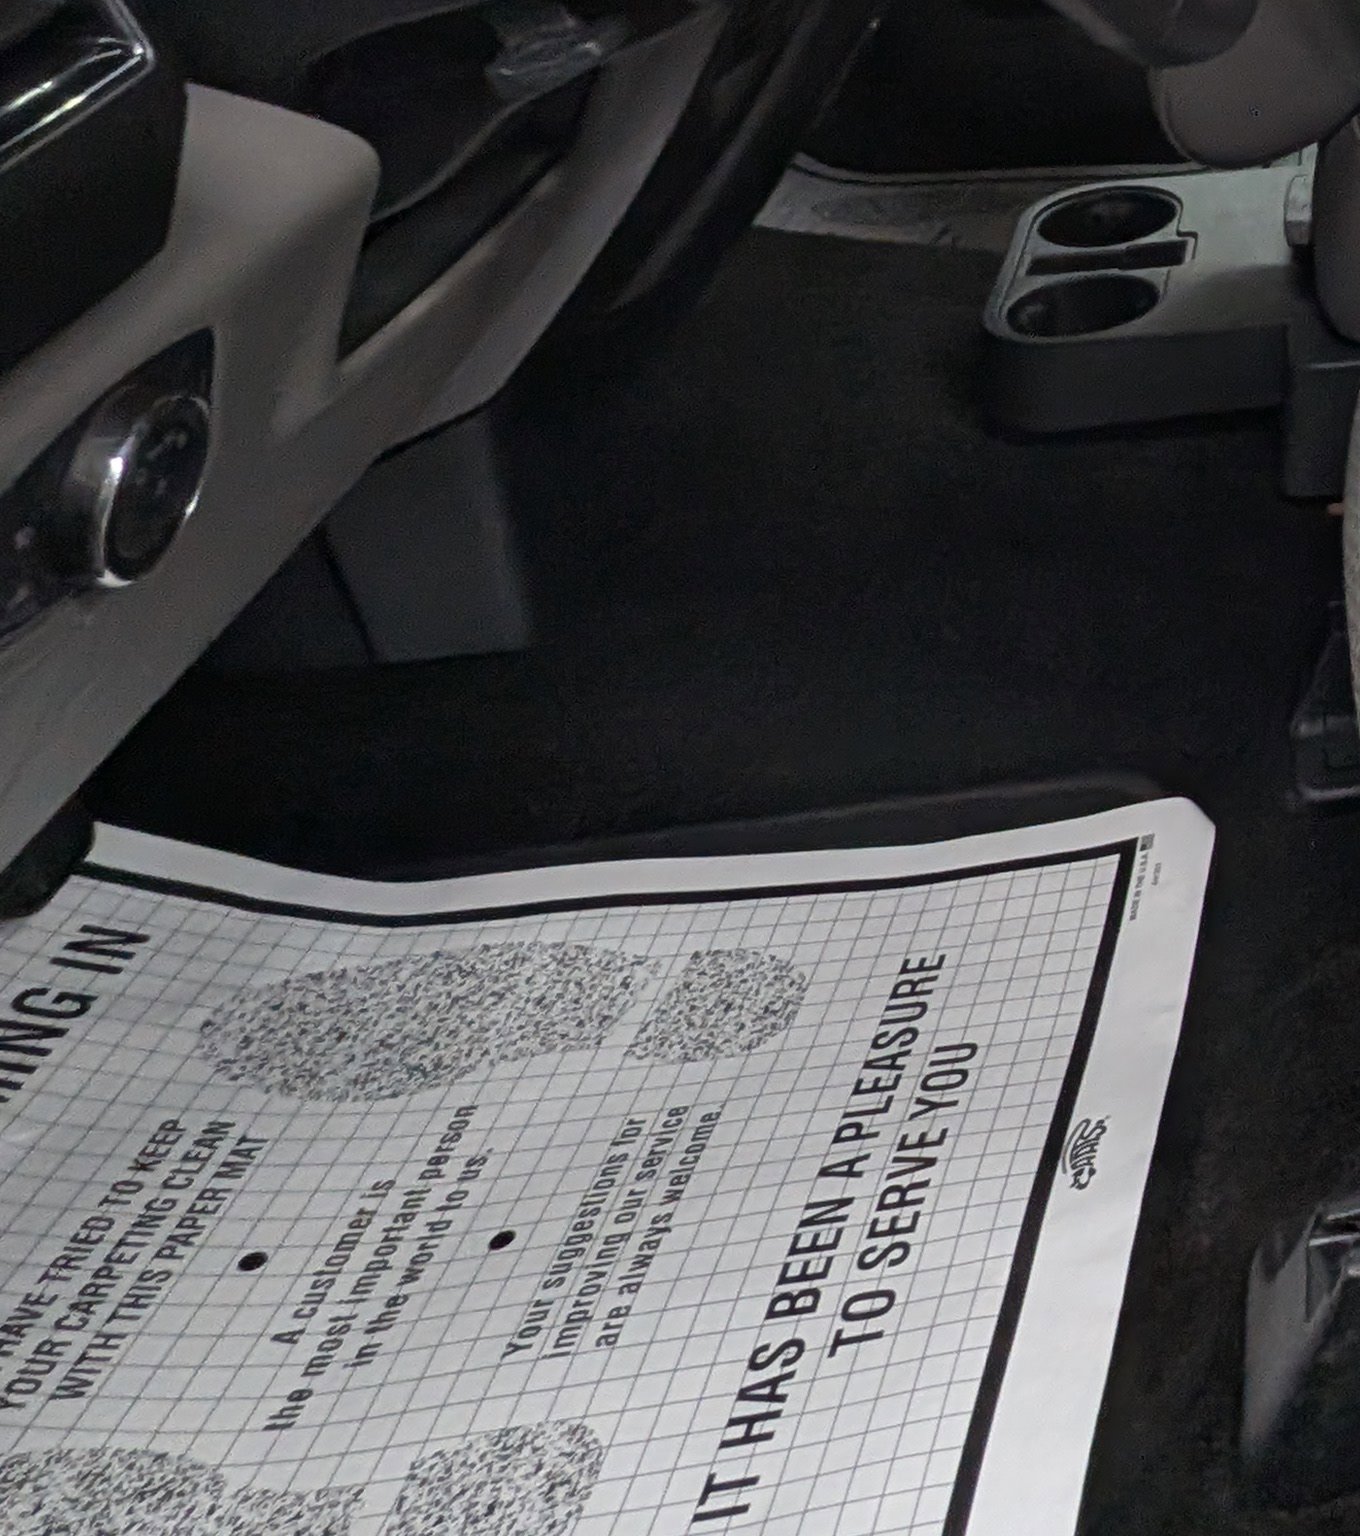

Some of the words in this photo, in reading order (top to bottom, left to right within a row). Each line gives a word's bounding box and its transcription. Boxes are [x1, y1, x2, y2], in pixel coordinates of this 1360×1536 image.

[50, 924, 150, 975] IN
[832, 953, 947, 1146] PLEASURE
[909, 1042, 978, 1121] YOU
[38, 1216, 115, 1285] TRIED
[98, 1180, 144, 1208] TO
[127, 1118, 187, 1172] KEEP
[500, 1299, 554, 1360] Your
[543, 1152, 630, 1291] suggestions
[610, 1117, 647, 1148] for
[541, 1231, 632, 1359] improving
[614, 1189, 647, 1225] our
[636, 1105, 689, 1182] service
[595, 1304, 632, 1348] are
[618, 1212, 674, 1296] always
[659, 1104, 724, 1206] welcome.
[817, 1152, 871, 1179] A
[857, 1127, 949, 1270] SERVE
[0, 1339, 72, 1408] YOUR
[54, 1198, 179, 1332] CARPETING
[162, 1121, 235, 1190] CLEAN
[49, 1331, 129, 1400] WITH
[103, 1269, 173, 1326] THIS
[152, 1188, 232, 1260] PAPER
[212, 1135, 269, 1179] MAT
[262, 1388, 314, 1431] the
[301, 1314, 358, 1377] most
[336, 1188, 432, 1305] important
[418, 1104, 479, 1181] person
[270, 1328, 306, 1345] A
[293, 1207, 378, 1319] customer
[360, 1179, 396, 1199] is
[343, 1342, 383, 1369] in
[364, 1293, 409, 1335] the
[398, 1219, 453, 1287] world
[436, 1189, 469, 1211] to
[458, 1148, 495, 1182] us.
[764, 1196, 855, 1321] BEEN
[827, 1289, 896, 1358] TO
[718, 1338, 805, 1450] HAS
[692, 1472, 760, 1524] IT
